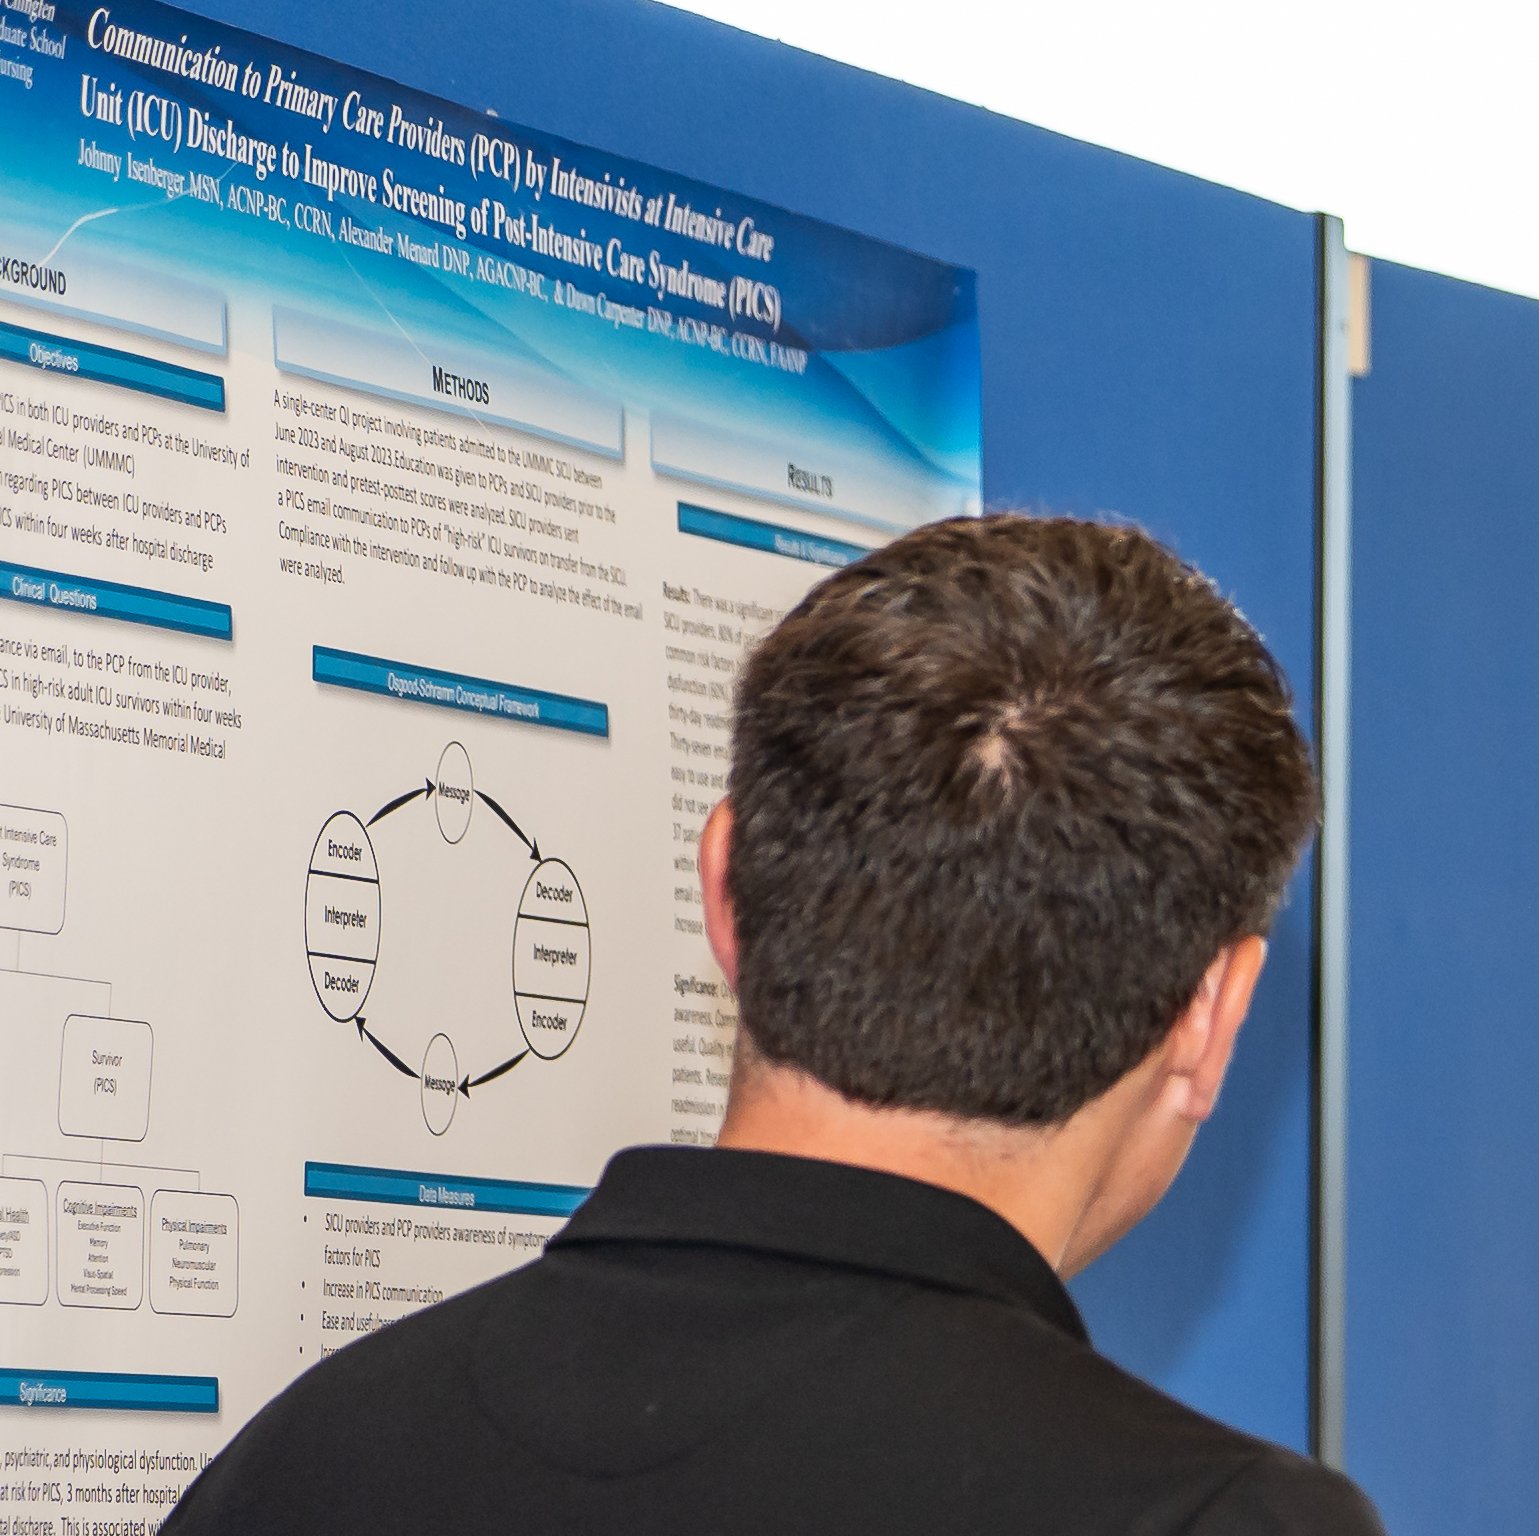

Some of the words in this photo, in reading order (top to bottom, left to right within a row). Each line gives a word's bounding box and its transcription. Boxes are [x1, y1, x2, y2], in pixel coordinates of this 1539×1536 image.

[30, 26, 68, 60] School
[0, 55, 34, 90] ursing
[87, 7, 239, 92] Communication
[241, 61, 262, 99] to
[262, 63, 339, 134] Primary
[342, 90, 385, 140] Care
[387, 103, 466, 166] Providers
[469, 132, 521, 194] (PCP)
[524, 149, 548, 202] by
[550, 156, 644, 222] Intensivists
[644, 193, 664, 227] at
[664, 192, 735, 251] Intensive
[736, 216, 776, 264] Care
[80, 74, 124, 126] Unit
[127, 90, 182, 154] (ICU)
[186, 107, 277, 181] Discharge
[281, 141, 300, 180] to
[303, 143, 378, 202] Improve
[382, 167, 467, 240] Screening
[471, 197, 490, 236] of
[493, 200, 603, 272] Post-Intensive
[606, 237, 646, 285] Care
[648, 249, 727, 309] Syndrome
[728, 274, 781, 335] (PICS)
[77, 137, 122, 182] Johnny
[127, 151, 185, 198] Isenberger
[189, 170, 224, 211] MSN,
[227, 183, 291, 231] ACNP-BC,
[294, 202, 336, 243] CCRN,
[338, 216, 394, 256] Alexander
[397, 232, 440, 268] Menard
[442, 245, 475, 282] DNP,
[476, 255, 549, 303] AGACNP-BC,
[553, 279, 565, 306] &
[0, 256, 66, 295] KGROUND
[29, 342, 79, 372] Objectives
[432, 365, 490, 405] METHODS
[273, 389, 281, 408] A
[282, 393, 337, 422] single-center
[339, 404, 350, 427] QI
[352, 410, 382, 434] project
[16, 395, 26, 417] in
[28, 397, 50, 422] both
[52, 404, 69, 427] ICU
[72, 413, 119, 438] providers
[122, 422, 139, 442] and
[164, 431, 173, 450] at
[175, 433, 189, 454] the
[191, 437, 238, 470] University
[240, 448, 251, 469] of
[274, 422, 296, 443] June
[298, 426, 320, 449] 2023
[320, 434, 337, 454] and
[338, 437, 369, 463] August
[7, 429, 45, 455] Medical
[46, 438, 79, 463] Center
[83, 444, 135, 479] (UMMMC)
[4, 471, 49, 501] regarding
[52, 477, 73, 501] PICS
[76, 483, 119, 511] between
[122, 493, 139, 515] ICU
[142, 500, 182, 524] providers
[184, 510, 202, 529] and
[204, 511, 227, 534] PCPs
[15, 512, 45, 535] within
[47, 515, 68, 540] four
[71, 523, 103, 547] weeks
[105, 528, 130, 552] after
[132, 532, 168, 561] hospital
[169, 542, 214, 573] discharge
[11, 575, 46, 601] Clinical
[49, 582, 97, 611] Questions
[24, 639, 39, 661] via
[41, 643, 71, 669] email,
[73, 648, 84, 668] to
[86, 649, 102, 672] the
[105, 651, 125, 674] PCP
[127, 655, 152, 680] from
[154, 661, 170, 683] the
[172, 664, 187, 686] ICU
[190, 670, 232, 697] provider,
[11, 670, 21, 691] in
[22, 671, 66, 699] high-risk
[67, 681, 93, 703] adult
[95, 686, 113, 707] ICU
[115, 691, 160, 715] survivors
[162, 698, 192, 721] within
[192, 701, 213, 724] four
[215, 708, 242, 730] weeks
[455, 684, 498, 712] Conceptual
[498, 694, 540, 719] Framework
[3, 704, 52, 735] University
[55, 712, 67, 733] of
[68, 715, 141, 746] Massachusetts
[143, 728, 188, 754] Memorial
[190, 734, 226, 760] Medical
[437, 781, 471, 805] Message
[3, 825, 38, 846] Intensive
[39, 830, 58, 847] Care
[2, 853, 41, 873] Syndrome
[327, 838, 364, 863] Encoder
[8, 879, 32, 900] (PICS)
[536, 880, 574, 904] Decoder
[324, 904, 368, 930] Interpreter
[533, 943, 578, 967] Interpreter
[324, 970, 360, 995] Decoder
[531, 1009, 568, 1033] Encoder
[91, 1049, 123, 1068] Survivor
[423, 1074, 456, 1095] Message
[418, 1184, 437, 1203] Data
[438, 1185, 475, 1207] Measures
[324, 1212, 343, 1233] SICU
[344, 1214, 380, 1238] providers
[381, 1216, 396, 1236] and
[396, 1218, 412, 1237] PCP
[324, 1244, 351, 1266] factors
[352, 1246, 363, 1267] for
[364, 1249, 381, 1268] PICS
[323, 1278, 355, 1299] Increase
[355, 1280, 364, 1299] in
[364, 1281, 381, 1300] PICS
[19, 1381, 67, 1407] Significance
[72, 1448, 137, 1475] physiological
[139, 1449, 198, 1475] dysfunction.
[74, 1483, 113, 1503] months
[115, 1485, 140, 1504] after
[142, 1485, 180, 1508] hospital
[60, 1516, 81, 1536] This
[82, 1517, 90, 1536] is
